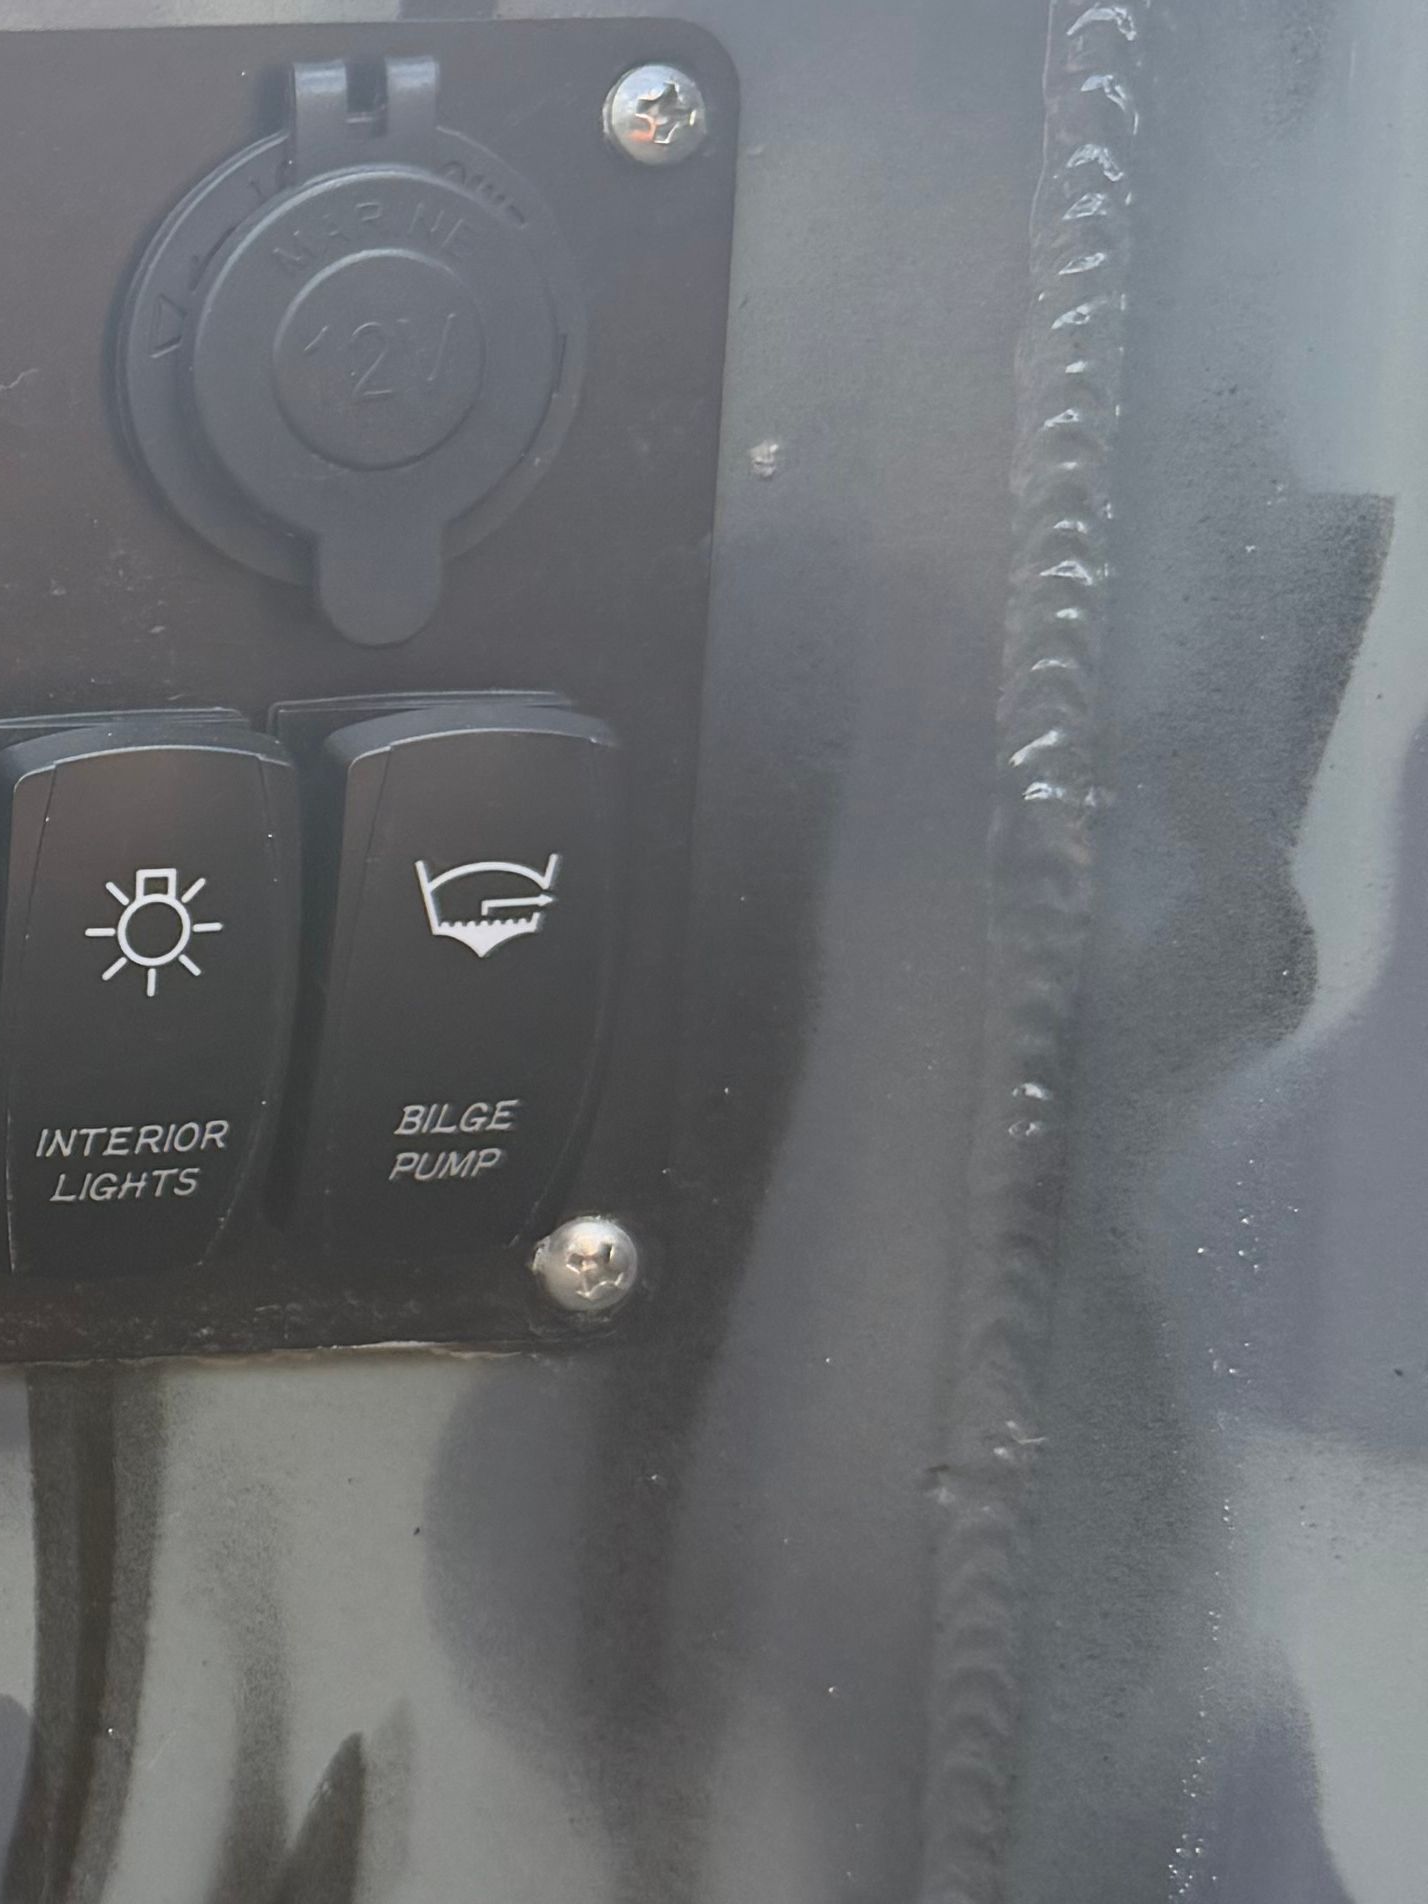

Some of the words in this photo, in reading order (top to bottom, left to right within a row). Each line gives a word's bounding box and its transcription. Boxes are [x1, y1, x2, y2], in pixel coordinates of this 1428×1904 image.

[302, 310, 458, 404] 12V
[393, 1098, 520, 1138] BILGE
[34, 1119, 231, 1161] INTERIOR
[389, 1146, 506, 1183] PUMP
[49, 1166, 202, 1205] LIGHTS
